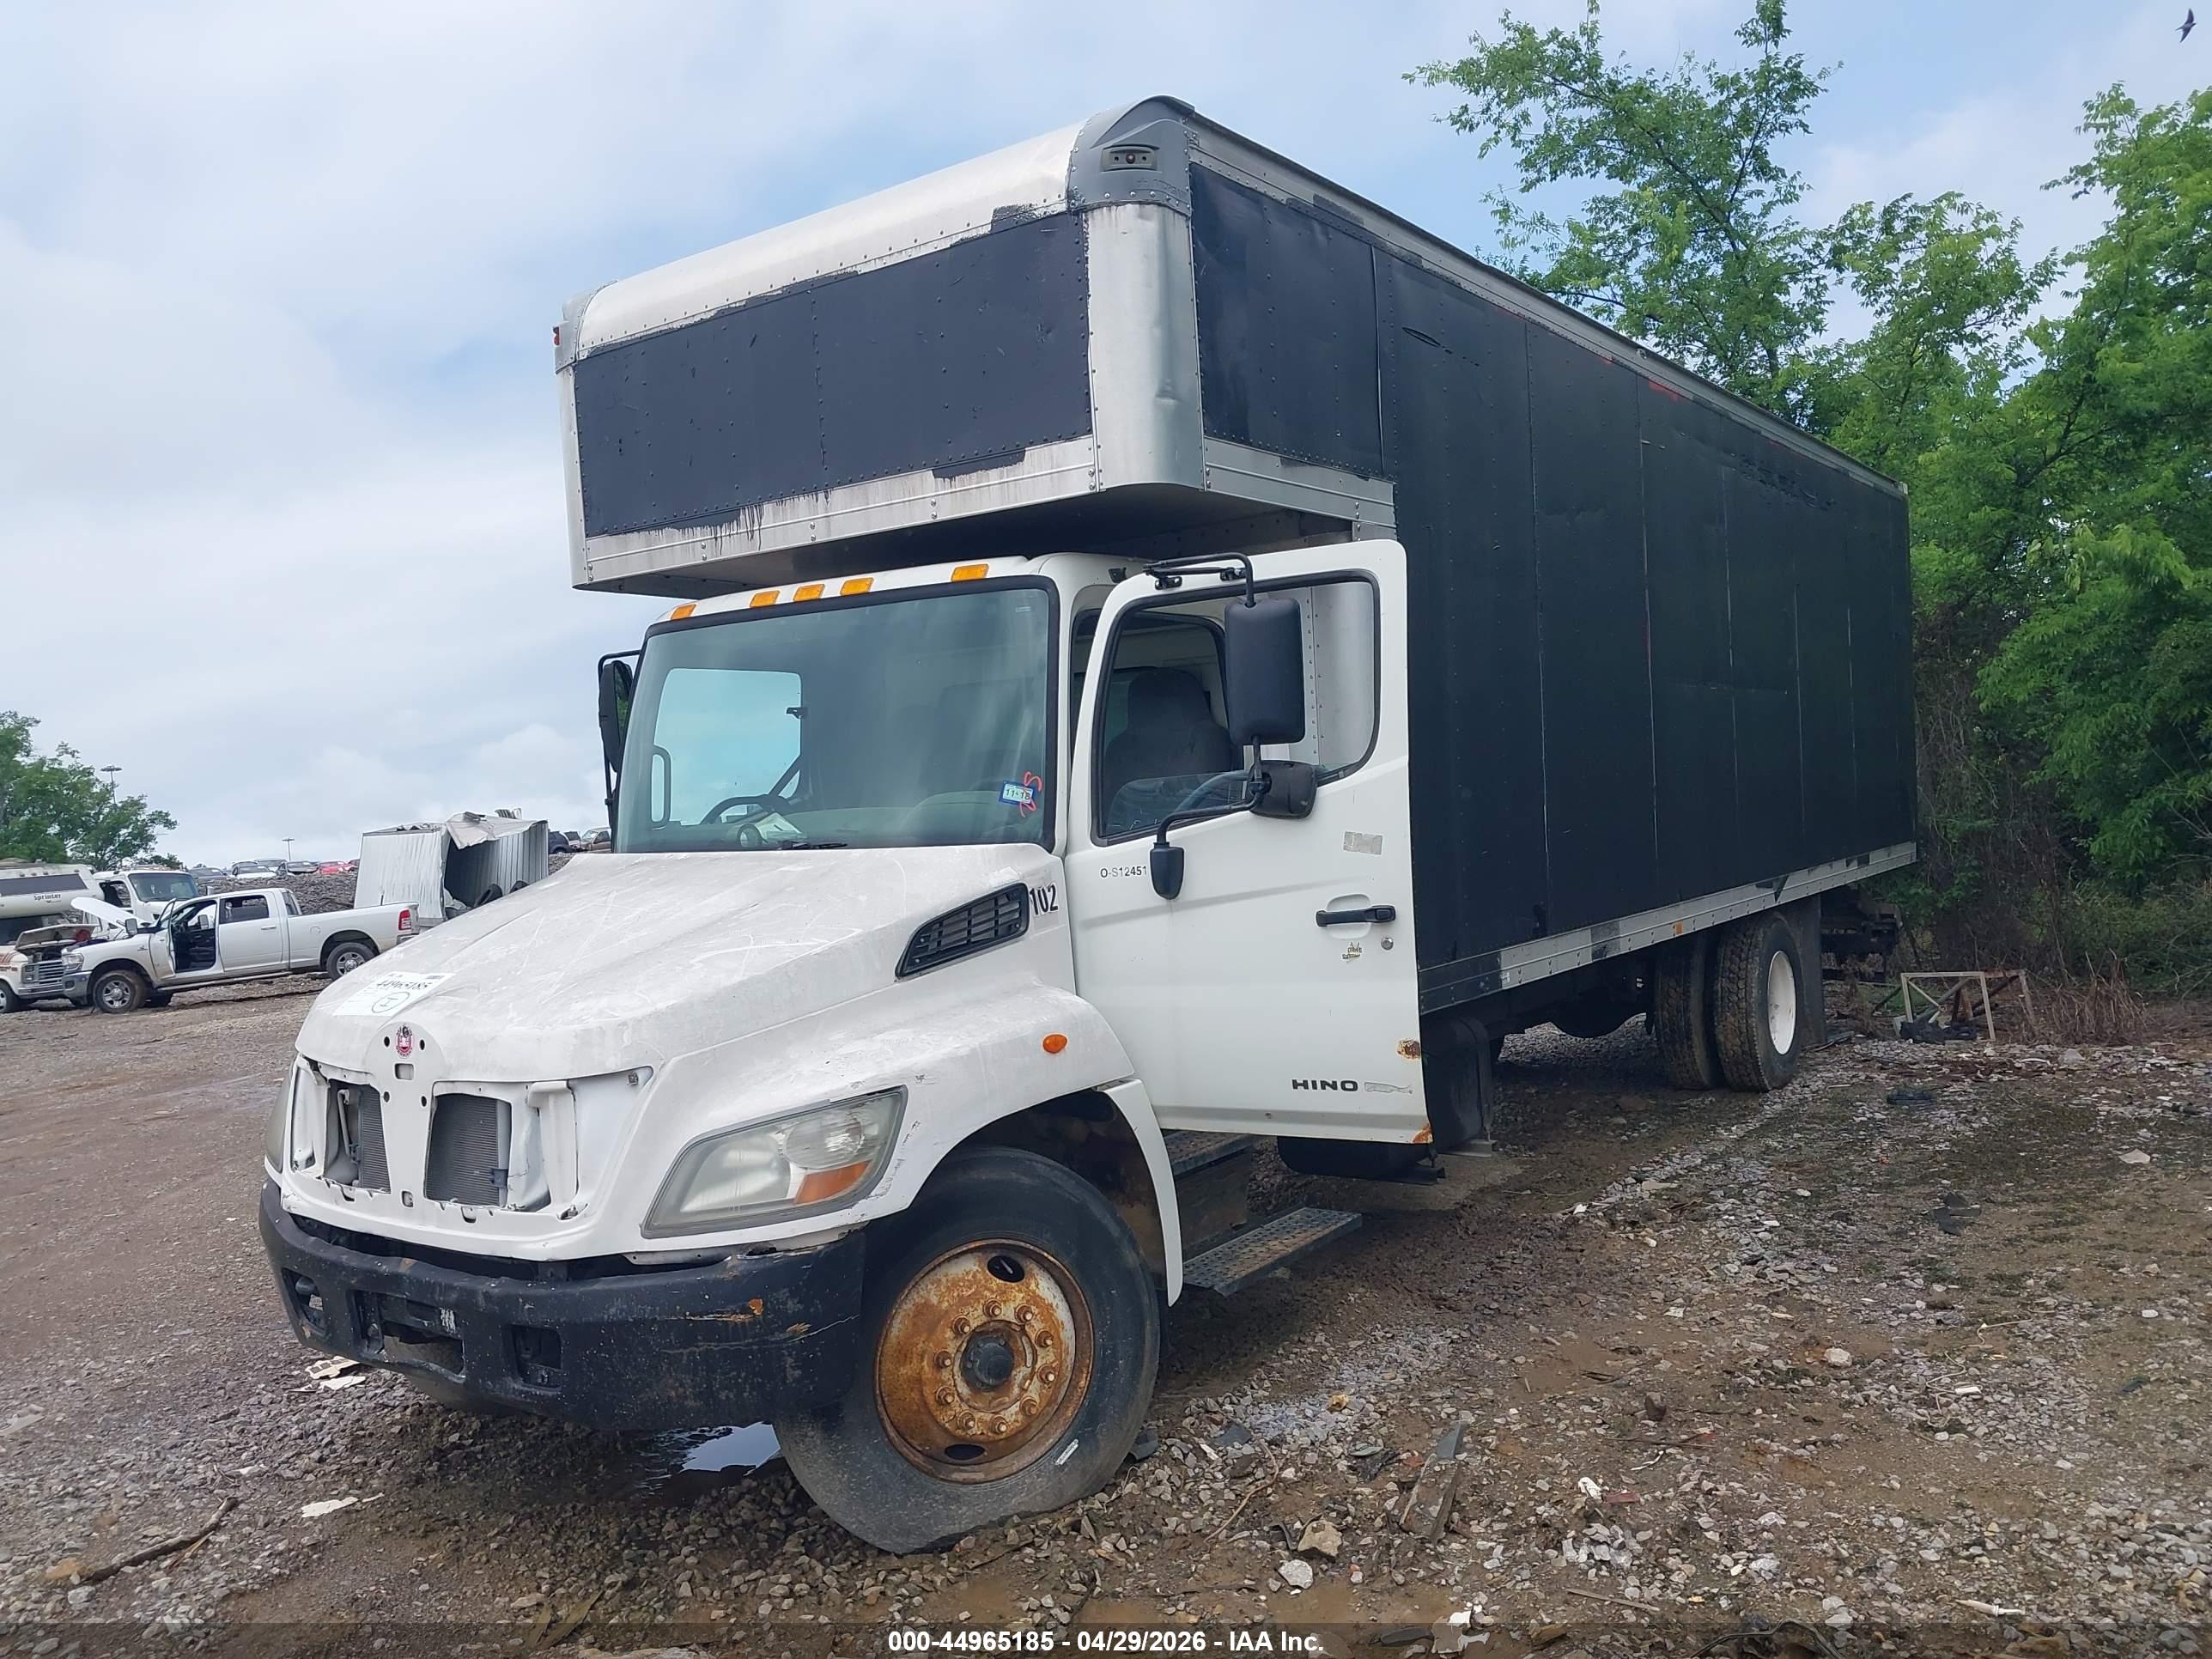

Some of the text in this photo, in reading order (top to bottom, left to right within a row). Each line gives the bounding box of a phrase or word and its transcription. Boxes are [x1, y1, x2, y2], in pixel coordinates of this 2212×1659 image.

[1100, 866, 1147, 878] O-S12451
[1030, 884, 1059, 915] 102
[1291, 1079, 1358, 1092] HINO
